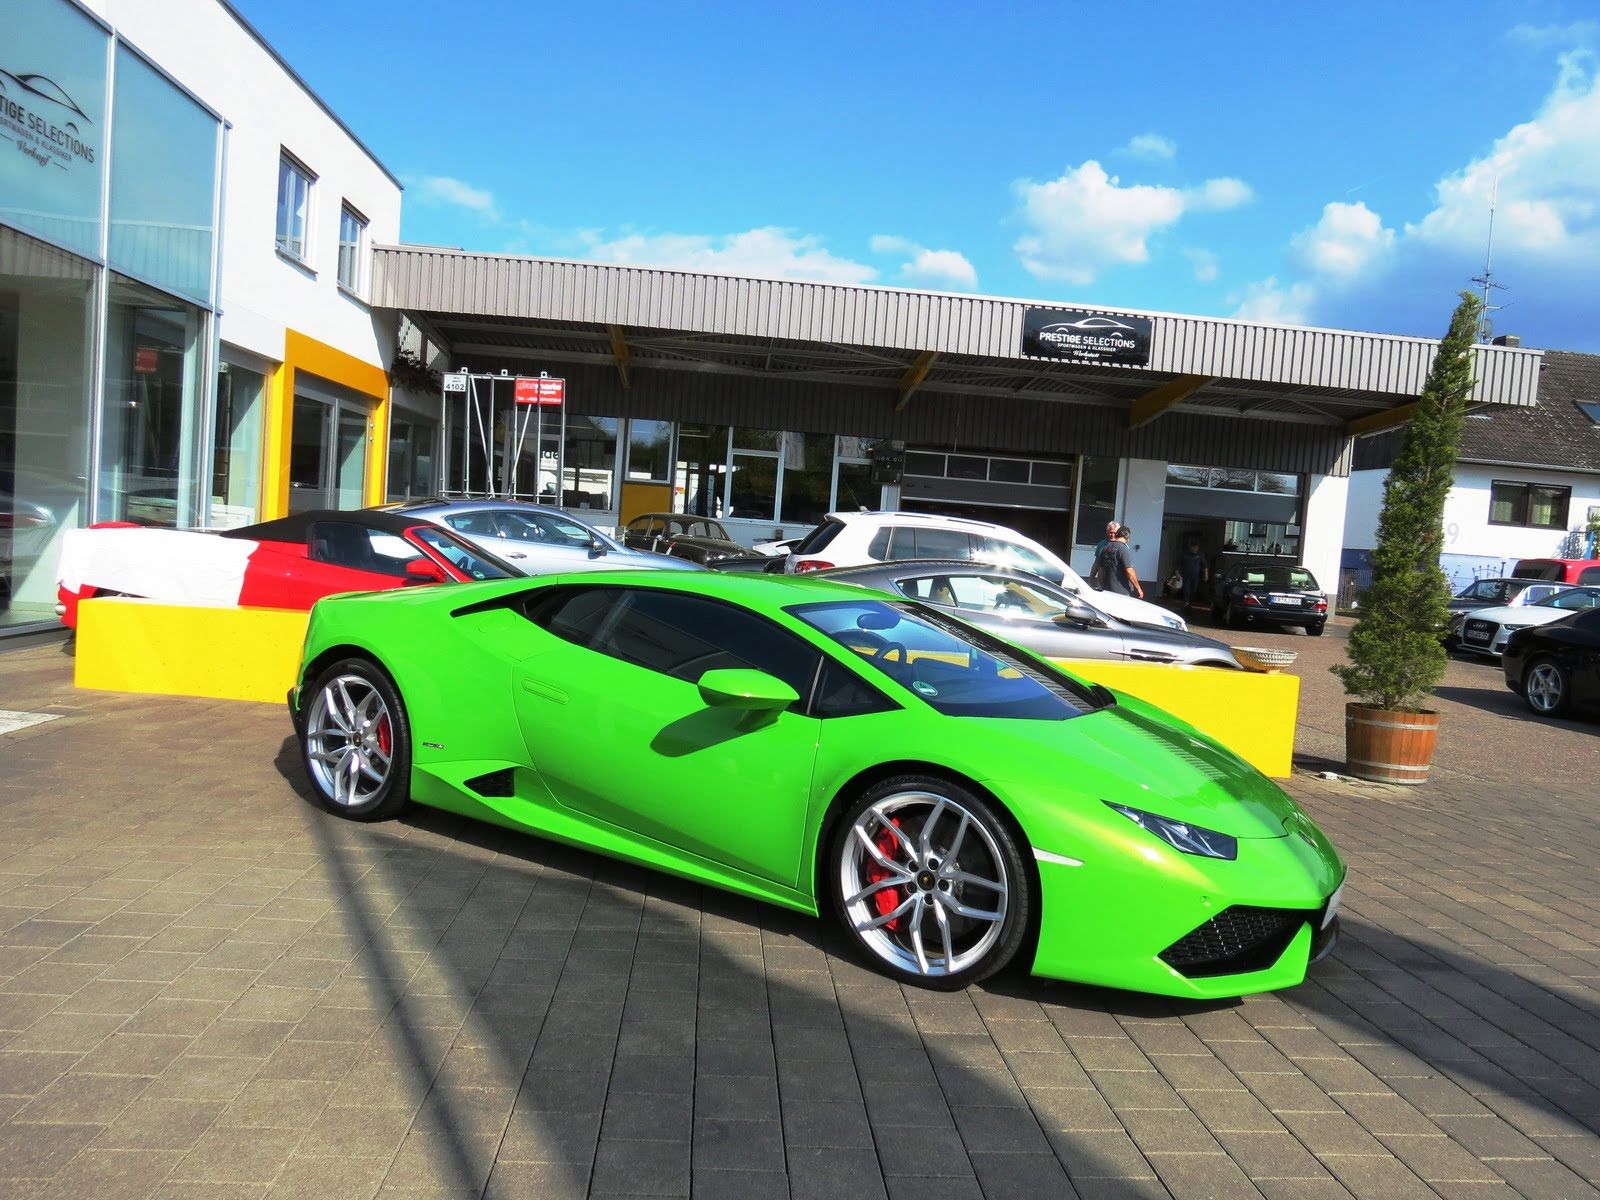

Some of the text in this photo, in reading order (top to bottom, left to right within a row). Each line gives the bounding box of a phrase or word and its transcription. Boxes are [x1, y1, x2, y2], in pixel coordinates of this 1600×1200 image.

[28, 112, 95, 163] SELECTIONS
[1040, 332, 1135, 349] PRESTIGE SELECTIONS
[445, 383, 465, 391] 4102
[1447, 522, 1460, 545] 9
